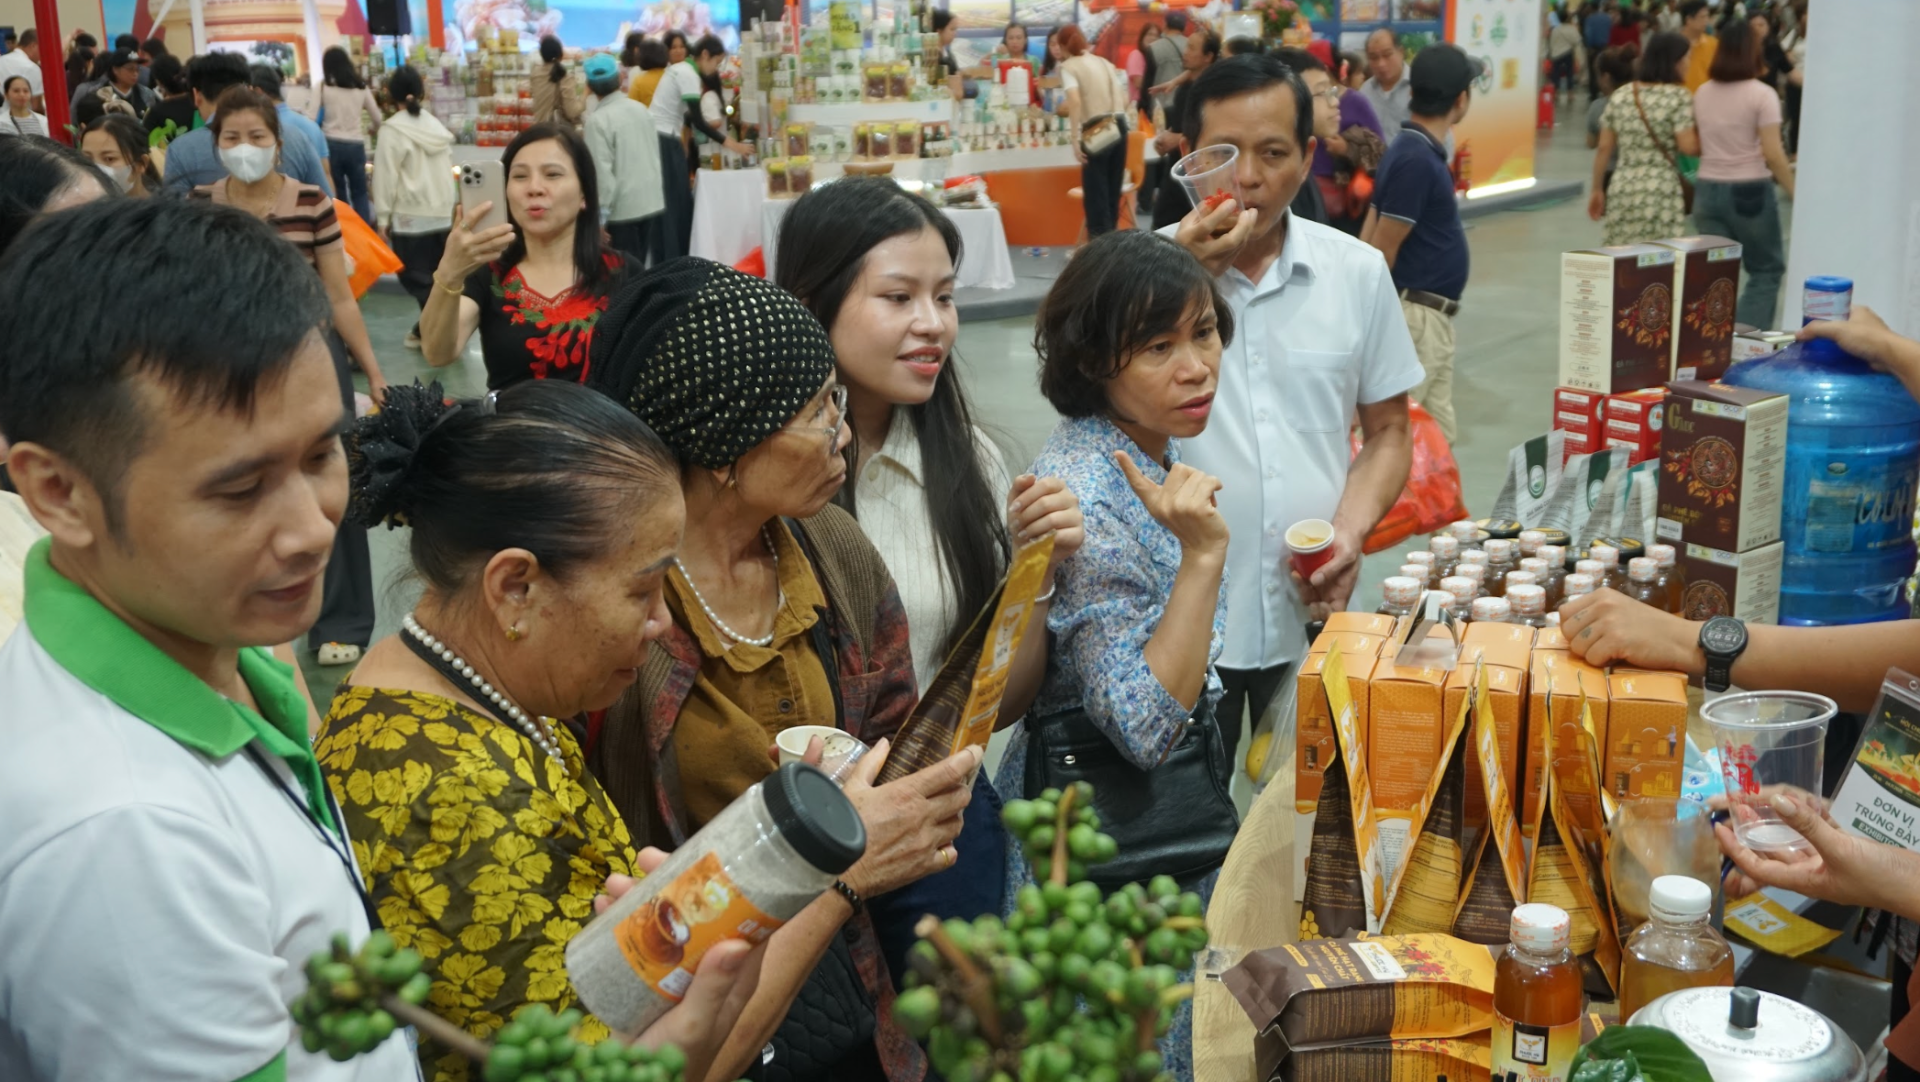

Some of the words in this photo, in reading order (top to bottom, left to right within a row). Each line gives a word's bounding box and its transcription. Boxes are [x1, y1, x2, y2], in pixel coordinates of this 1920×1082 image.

[1855, 802, 1895, 832] TRƯNG
[1895, 828, 1920, 846] BÀY
[1873, 796, 1901, 818] ĐƠN
[1903, 812, 1915, 829] VỊ
